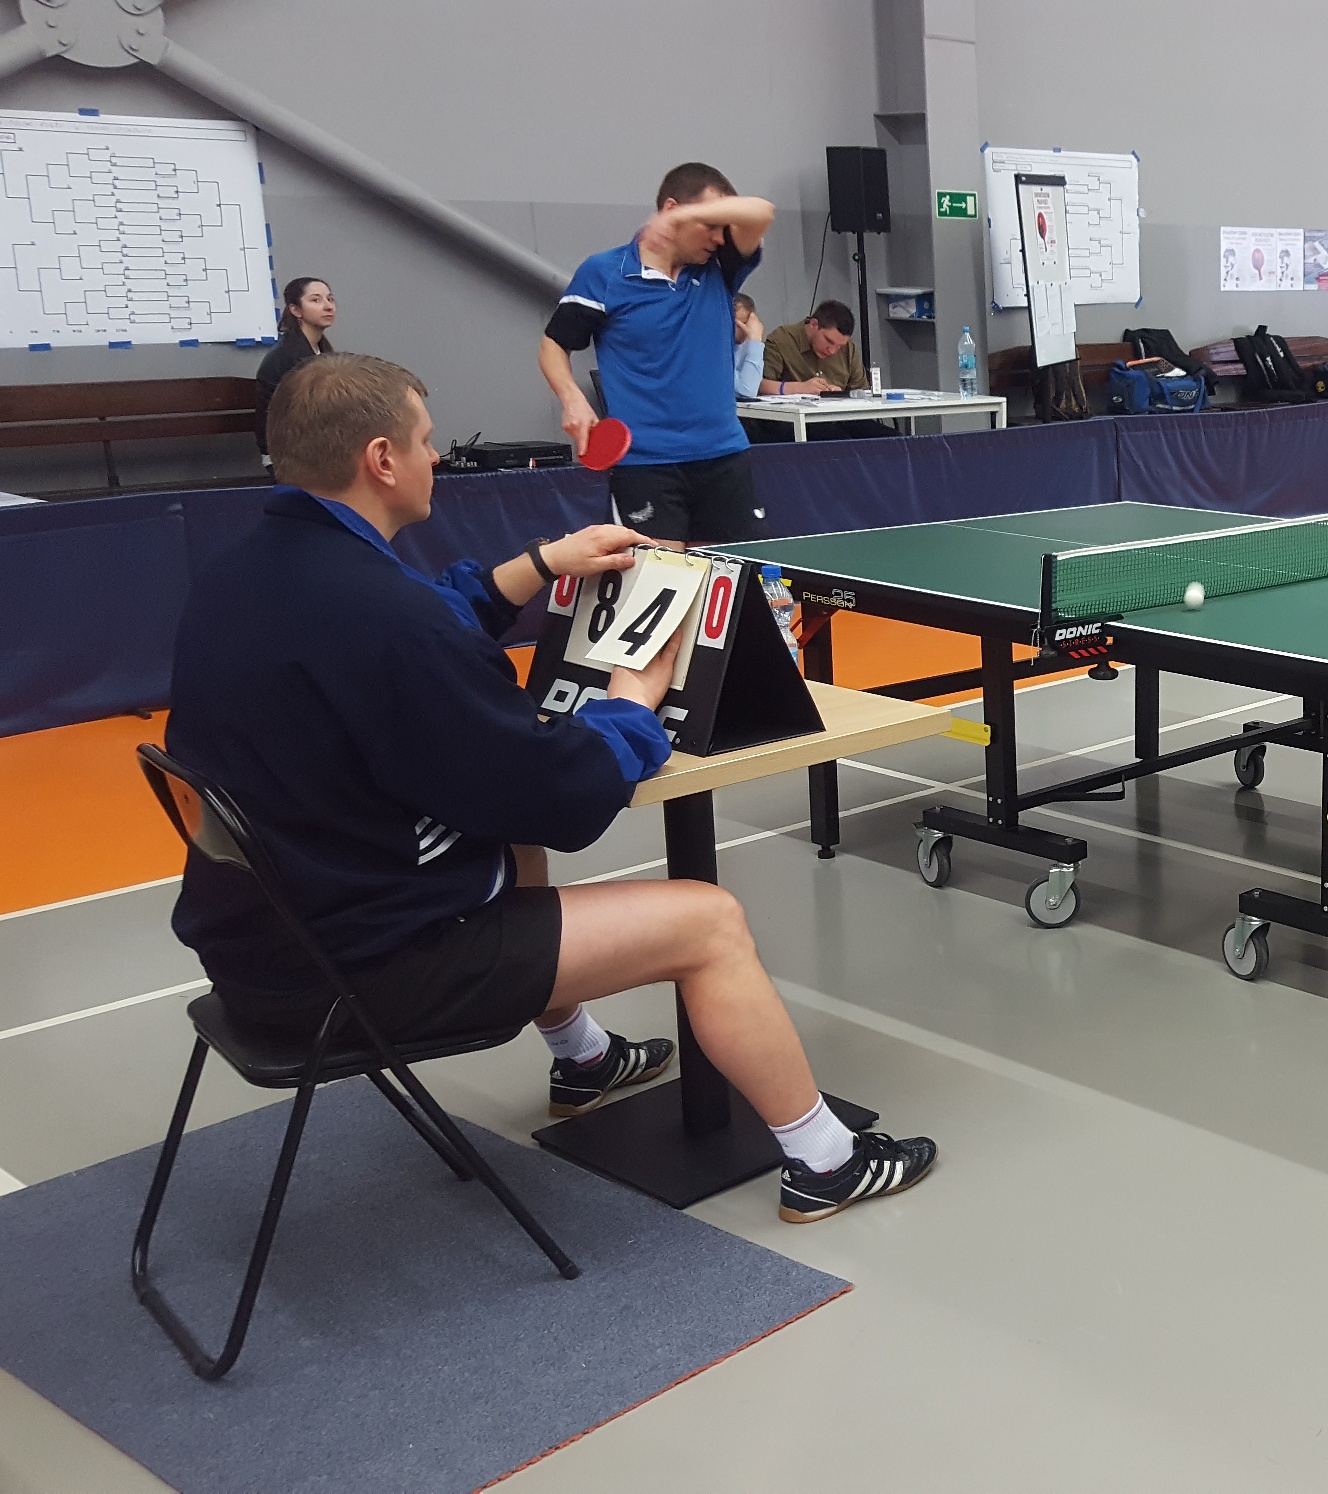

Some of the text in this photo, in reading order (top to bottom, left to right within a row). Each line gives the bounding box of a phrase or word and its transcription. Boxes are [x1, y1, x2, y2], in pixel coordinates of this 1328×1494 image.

[588, 569, 678, 657] 8 4
[704, 575, 733, 640] 0
[802, 591, 853, 609] PERSSON
[1055, 622, 1102, 641] DONIC
